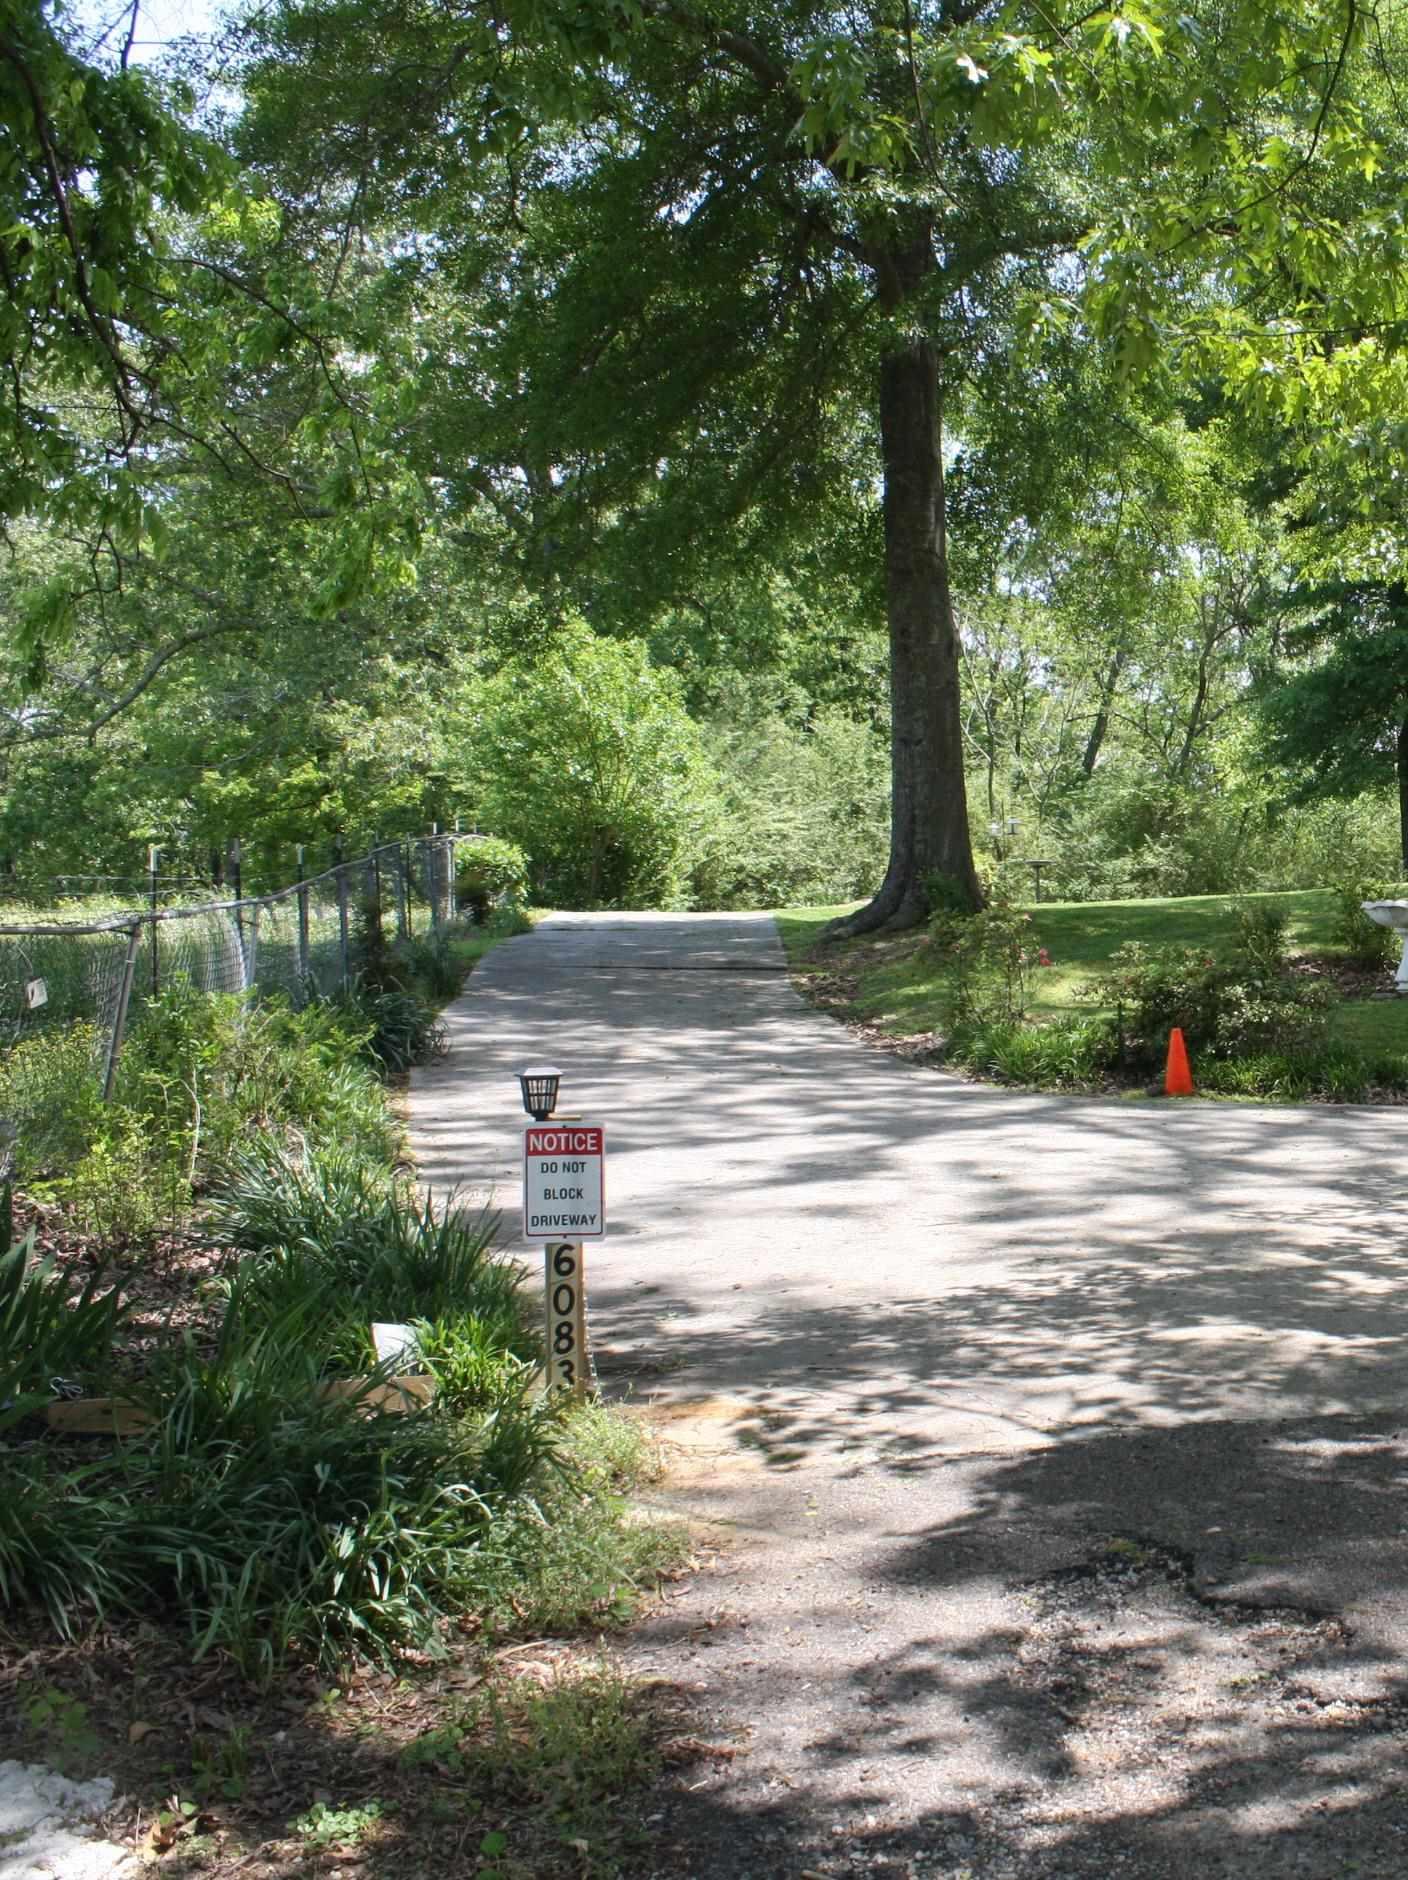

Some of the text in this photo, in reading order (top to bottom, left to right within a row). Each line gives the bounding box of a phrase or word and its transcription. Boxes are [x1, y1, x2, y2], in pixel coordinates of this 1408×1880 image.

[529, 1133, 598, 1152] NOTICE
[540, 1162, 586, 1173] DO NOT
[543, 1188, 583, 1200] BLOCK
[531, 1215, 597, 1227] DRIVEWAY
